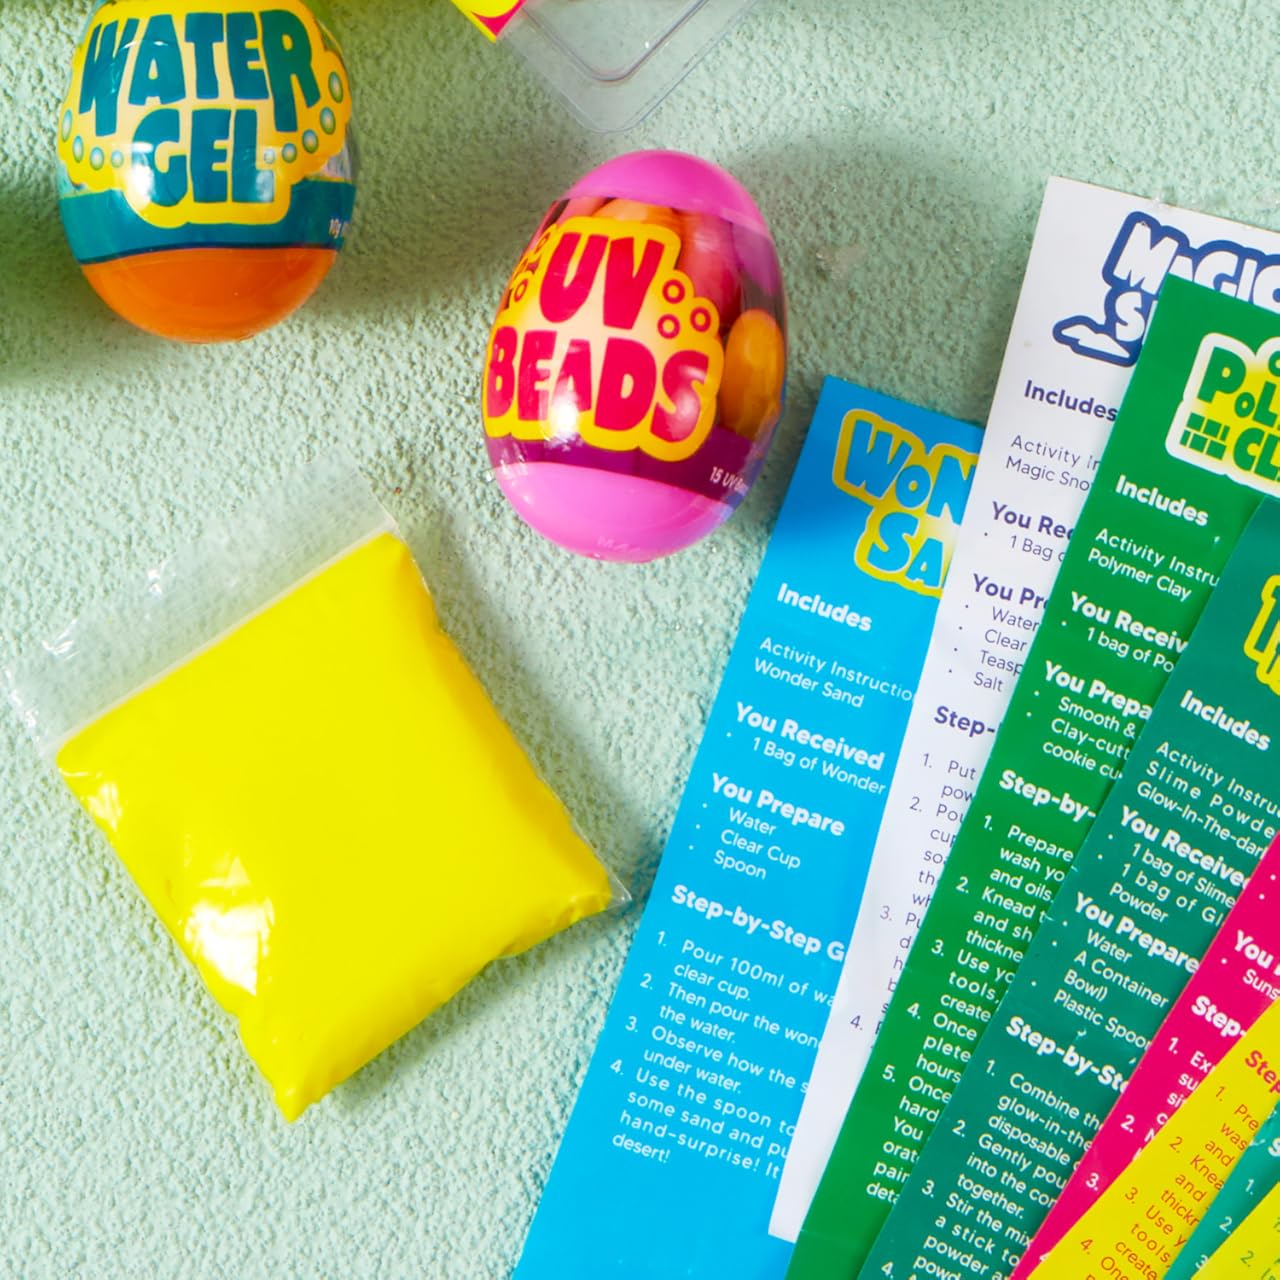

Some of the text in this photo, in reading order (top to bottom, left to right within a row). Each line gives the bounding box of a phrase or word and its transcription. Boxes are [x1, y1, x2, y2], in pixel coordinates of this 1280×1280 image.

[79, 9, 320, 136] WATER
[128, 109, 274, 206] GEL
[540, 232, 664, 330] UV
[488, 326, 709, 442] BEADS
[1024, 380, 1118, 421] Includes
[1011, 435, 1080, 466] Activity
[1115, 475, 1208, 526] Includes
[1096, 528, 1165, 569] Activity
[1088, 548, 1192, 602] Polymer Clay
[777, 584, 872, 632] Includes
[992, 607, 1039, 631] Water
[761, 638, 825, 671] Activity
[985, 630, 1027, 652] Clear
[1087, 627, 1149, 664] 1 bag of
[754, 659, 864, 708] Wonder Sand
[974, 672, 1003, 691] Salt
[737, 703, 885, 768] You Received
[1058, 697, 1136, 739] Smooth &
[1180, 690, 1271, 751] Includes
[753, 737, 886, 796] 1 Bag of Wonder
[1043, 742, 1096, 770] cookie
[1157, 741, 1224, 787] Activity
[1146, 761, 1202, 798] Slime
[712, 773, 845, 836] You Prepare
[729, 808, 776, 836] Water
[721, 829, 801, 869] Clear Cup
[1008, 826, 1074, 862] Prepare
[714, 851, 767, 879] Spoon
[982, 887, 1036, 920] Knead
[1110, 883, 1169, 922] Powder
[1075, 893, 1200, 974] You Prepare
[1087, 928, 1133, 963] Water
[674, 964, 751, 1002] clear cup.
[1064, 971, 1109, 1002] Bowl)
[1074, 950, 1168, 1009] A Container
[660, 1004, 736, 1044] the water.
[940, 994, 992, 1022] create
[1054, 990, 1102, 1025] Plastic
[643, 1049, 742, 1093] under water.
[917, 1053, 961, 1083] hours
[899, 1096, 940, 1123] hard
[1010, 1074, 1080, 1118] Combine
[612, 1133, 670, 1163] desert!
[620, 1110, 760, 1171] hand-surprise!
[978, 1134, 1032, 1171] Gently
[989, 1116, 1071, 1167] disposable
[957, 1174, 1024, 1219] together.
[1146, 1205, 1173, 1235] Use
[1131, 1223, 1170, 1268] tools,
